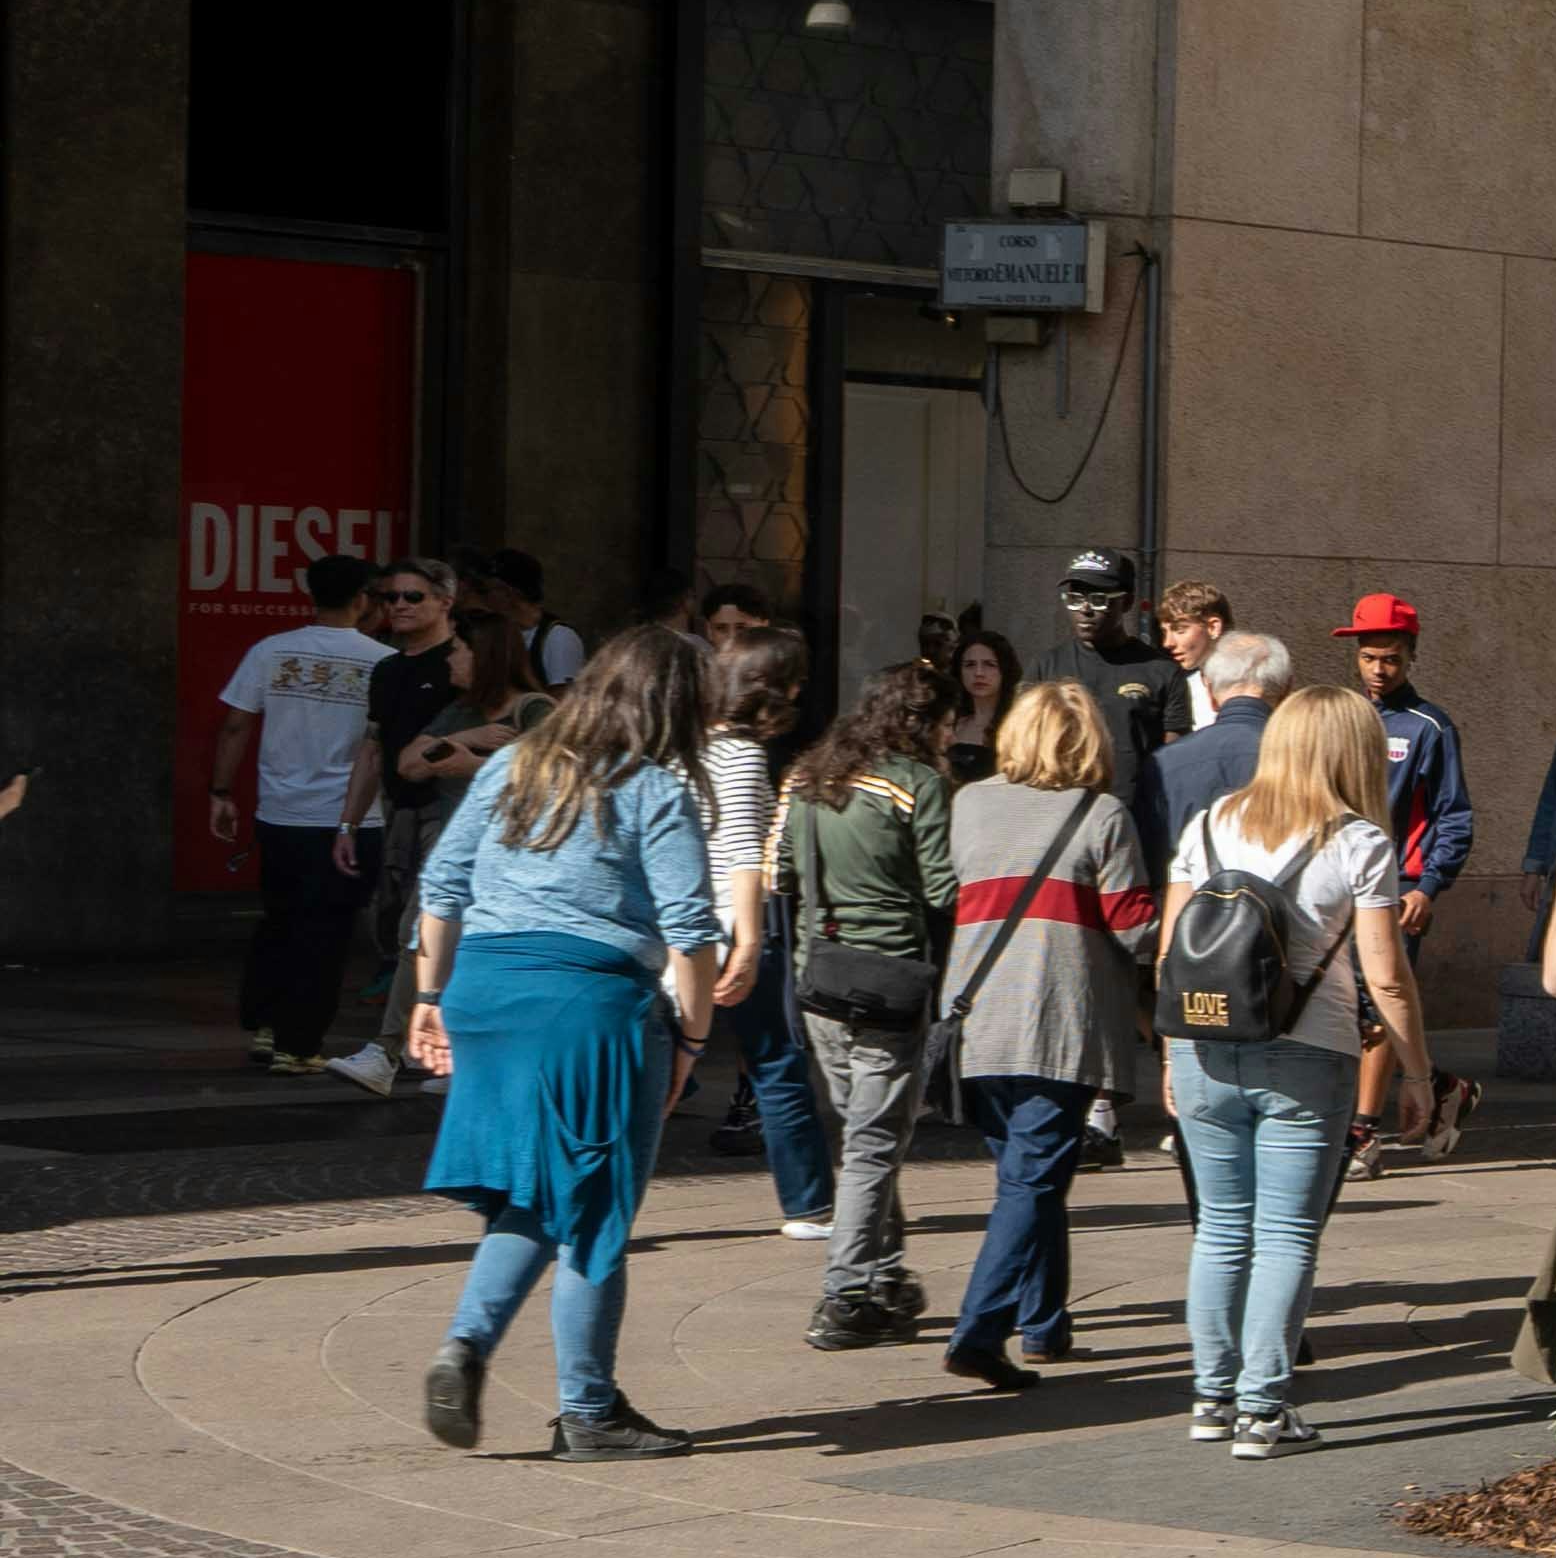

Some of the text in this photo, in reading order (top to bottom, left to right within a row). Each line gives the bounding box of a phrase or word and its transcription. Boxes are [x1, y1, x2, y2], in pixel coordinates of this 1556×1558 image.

[1000, 235, 1037, 248] CORSO
[996, 263, 1072, 283] EMANUELE
[188, 602, 224, 615] FOR
[1182, 991, 1229, 1016] LOVE
